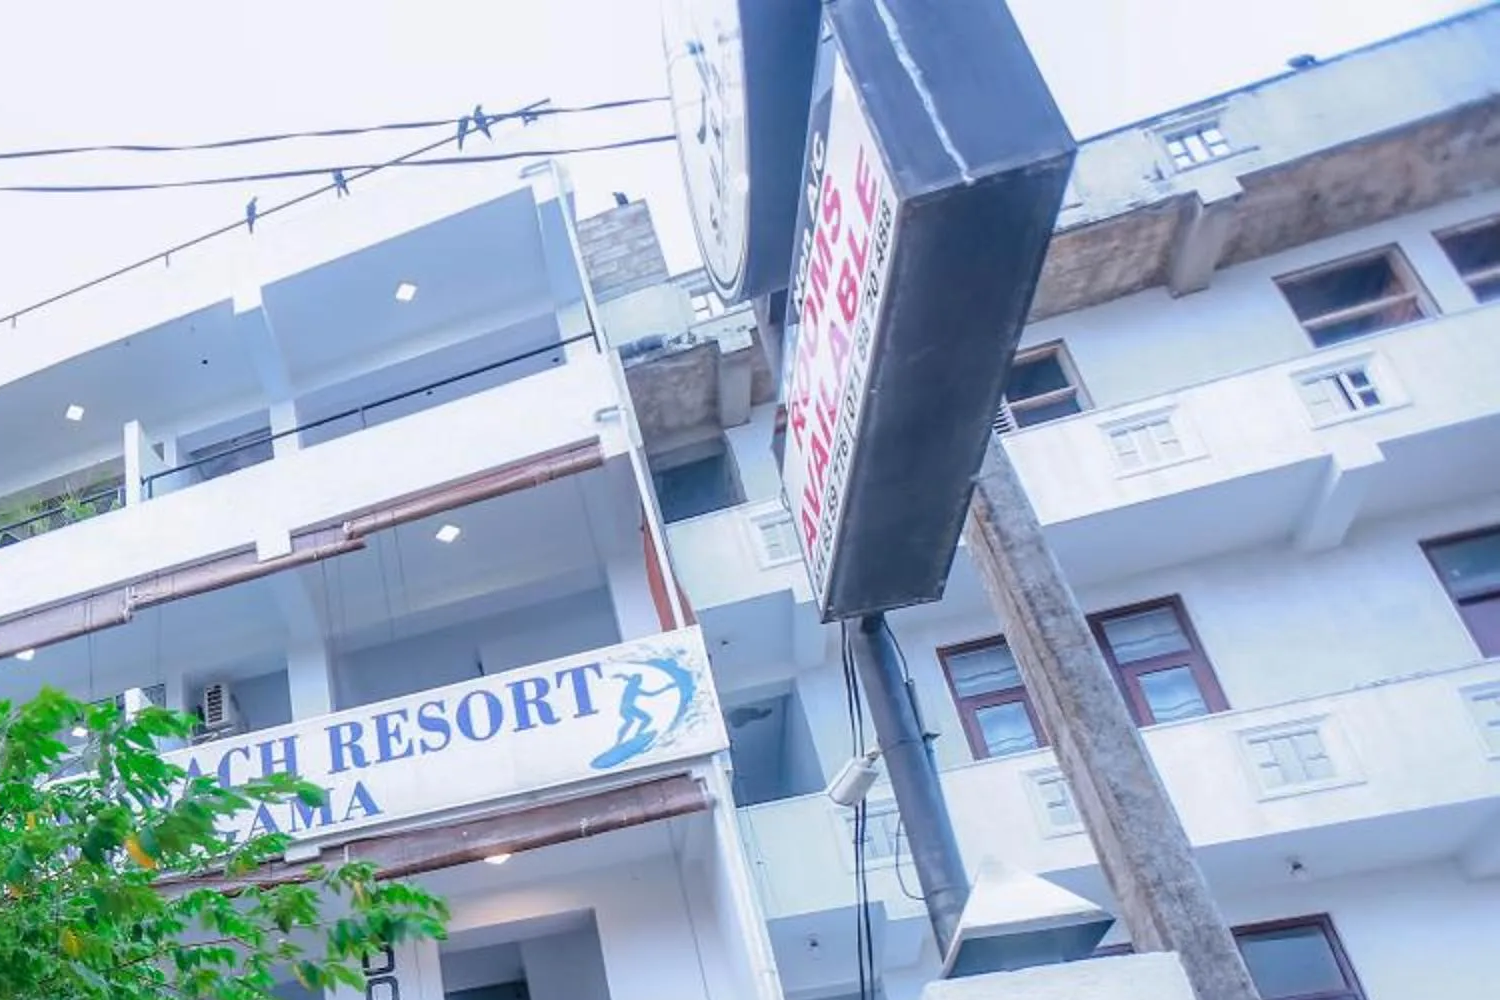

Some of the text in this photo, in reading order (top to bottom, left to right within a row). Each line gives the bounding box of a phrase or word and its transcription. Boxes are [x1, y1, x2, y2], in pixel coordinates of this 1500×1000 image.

[791, 173, 842, 451] ROOMS
[802, 144, 877, 560] AVAILABLE
[324, 661, 602, 775] RESORT
